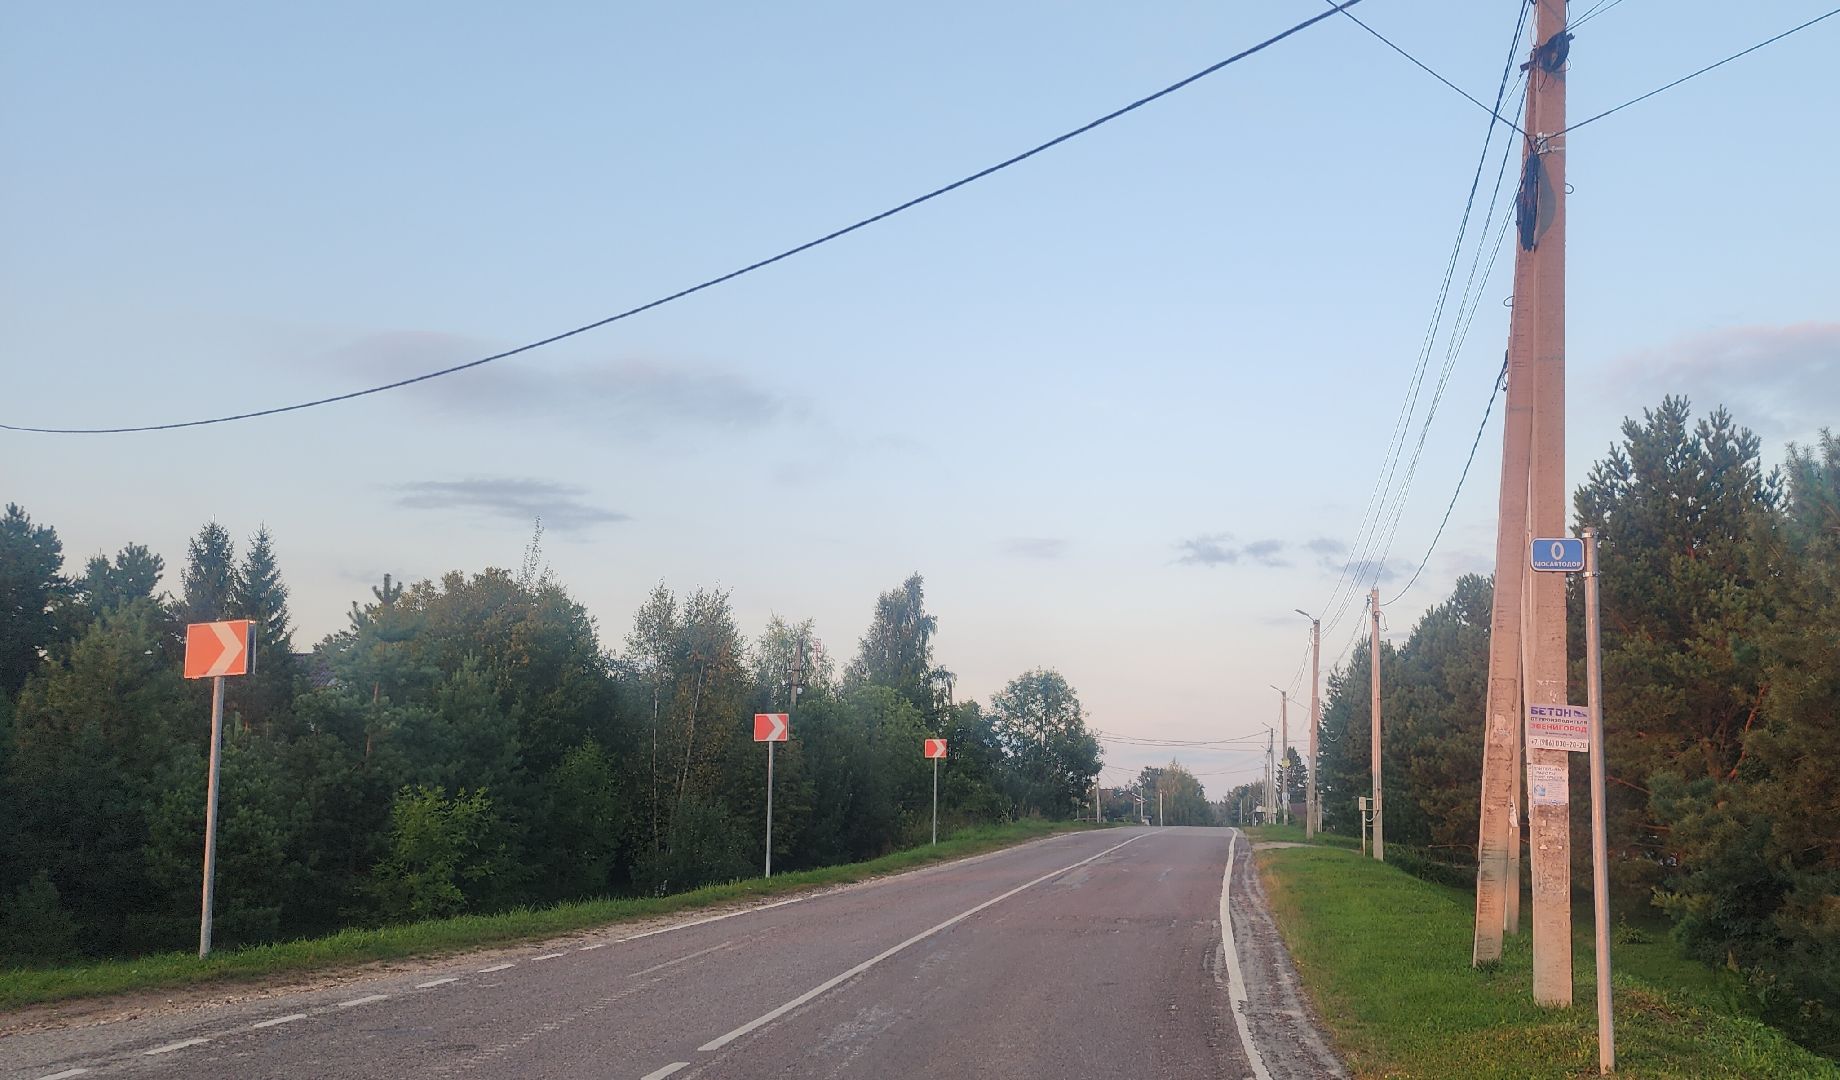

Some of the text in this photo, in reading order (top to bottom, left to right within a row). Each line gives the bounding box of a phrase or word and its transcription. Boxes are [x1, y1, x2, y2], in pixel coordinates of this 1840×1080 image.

[1531, 706, 1571, 717] БЕТОН
[1539, 717, 1587, 725] ПРОИЗВОДИТЕЛЯ
[1530, 723, 1587, 733] ЗВЕНИГОРОД
